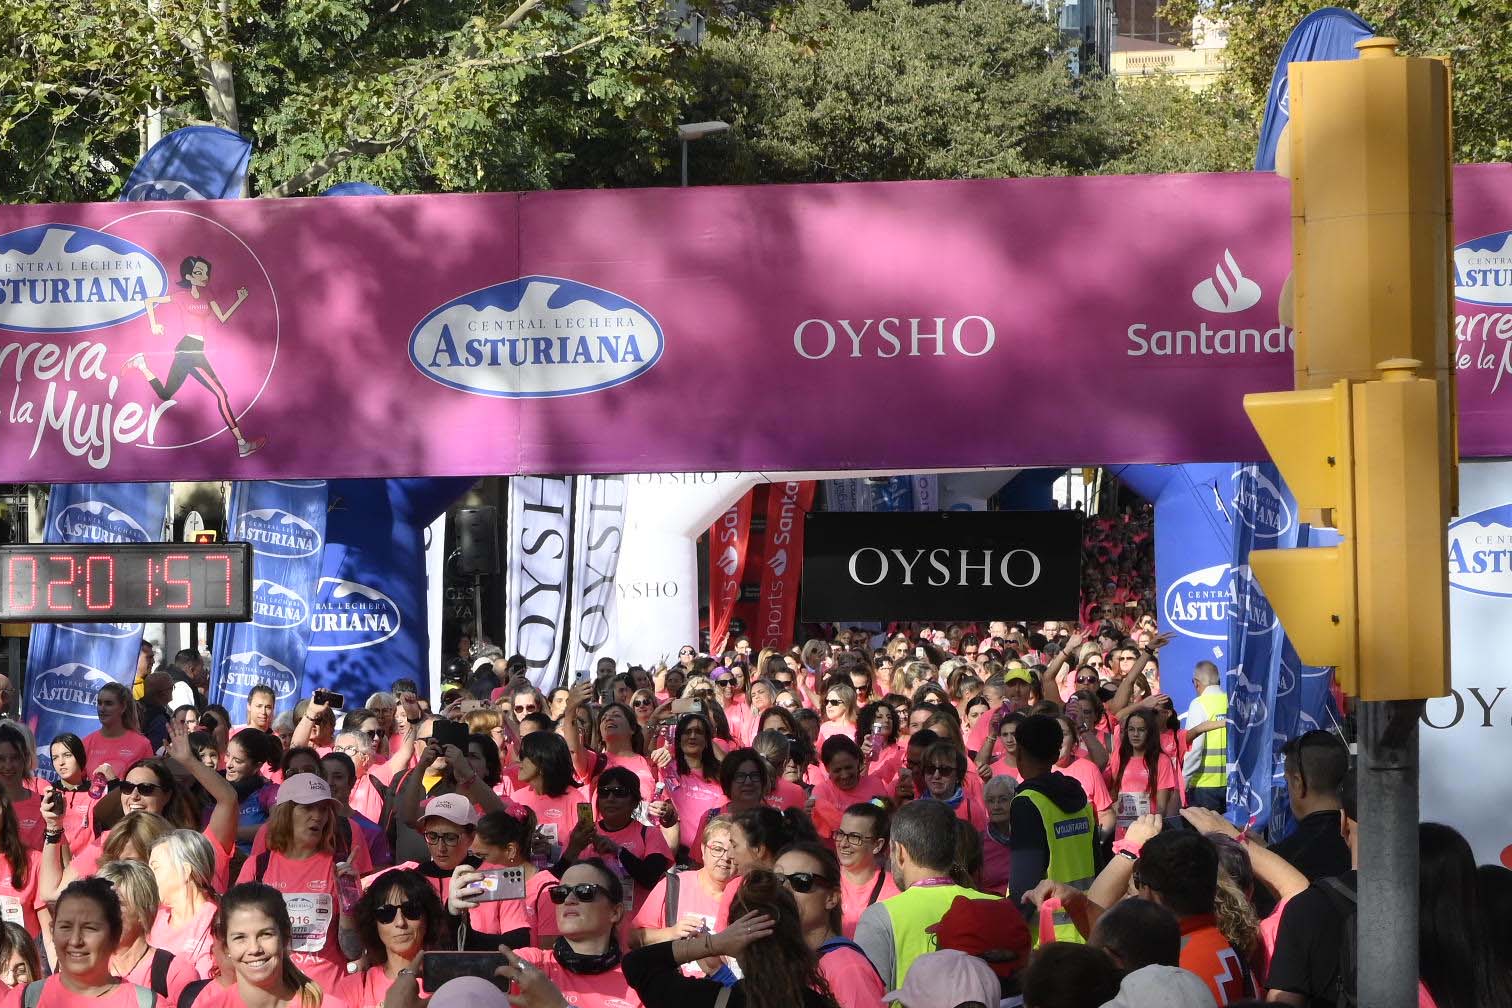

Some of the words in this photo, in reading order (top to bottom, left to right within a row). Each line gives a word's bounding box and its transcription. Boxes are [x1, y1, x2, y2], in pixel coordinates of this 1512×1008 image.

[70, 259, 143, 271] LECHERA
[468, 317, 547, 331] CENTRAL
[553, 315, 637, 329] LECHERA
[428, 323, 645, 368] ASTURIANA
[793, 316, 997, 360] OYSHO
[1477, 343, 1495, 369] la
[9, 384, 34, 424] la
[29, 375, 178, 469] Mujer
[238, 520, 313, 551] ASTURIANA
[848, 547, 1041, 588] OYSHO
[338, 602, 387, 610] LECHERA
[311, 612, 391, 632] URIANA
